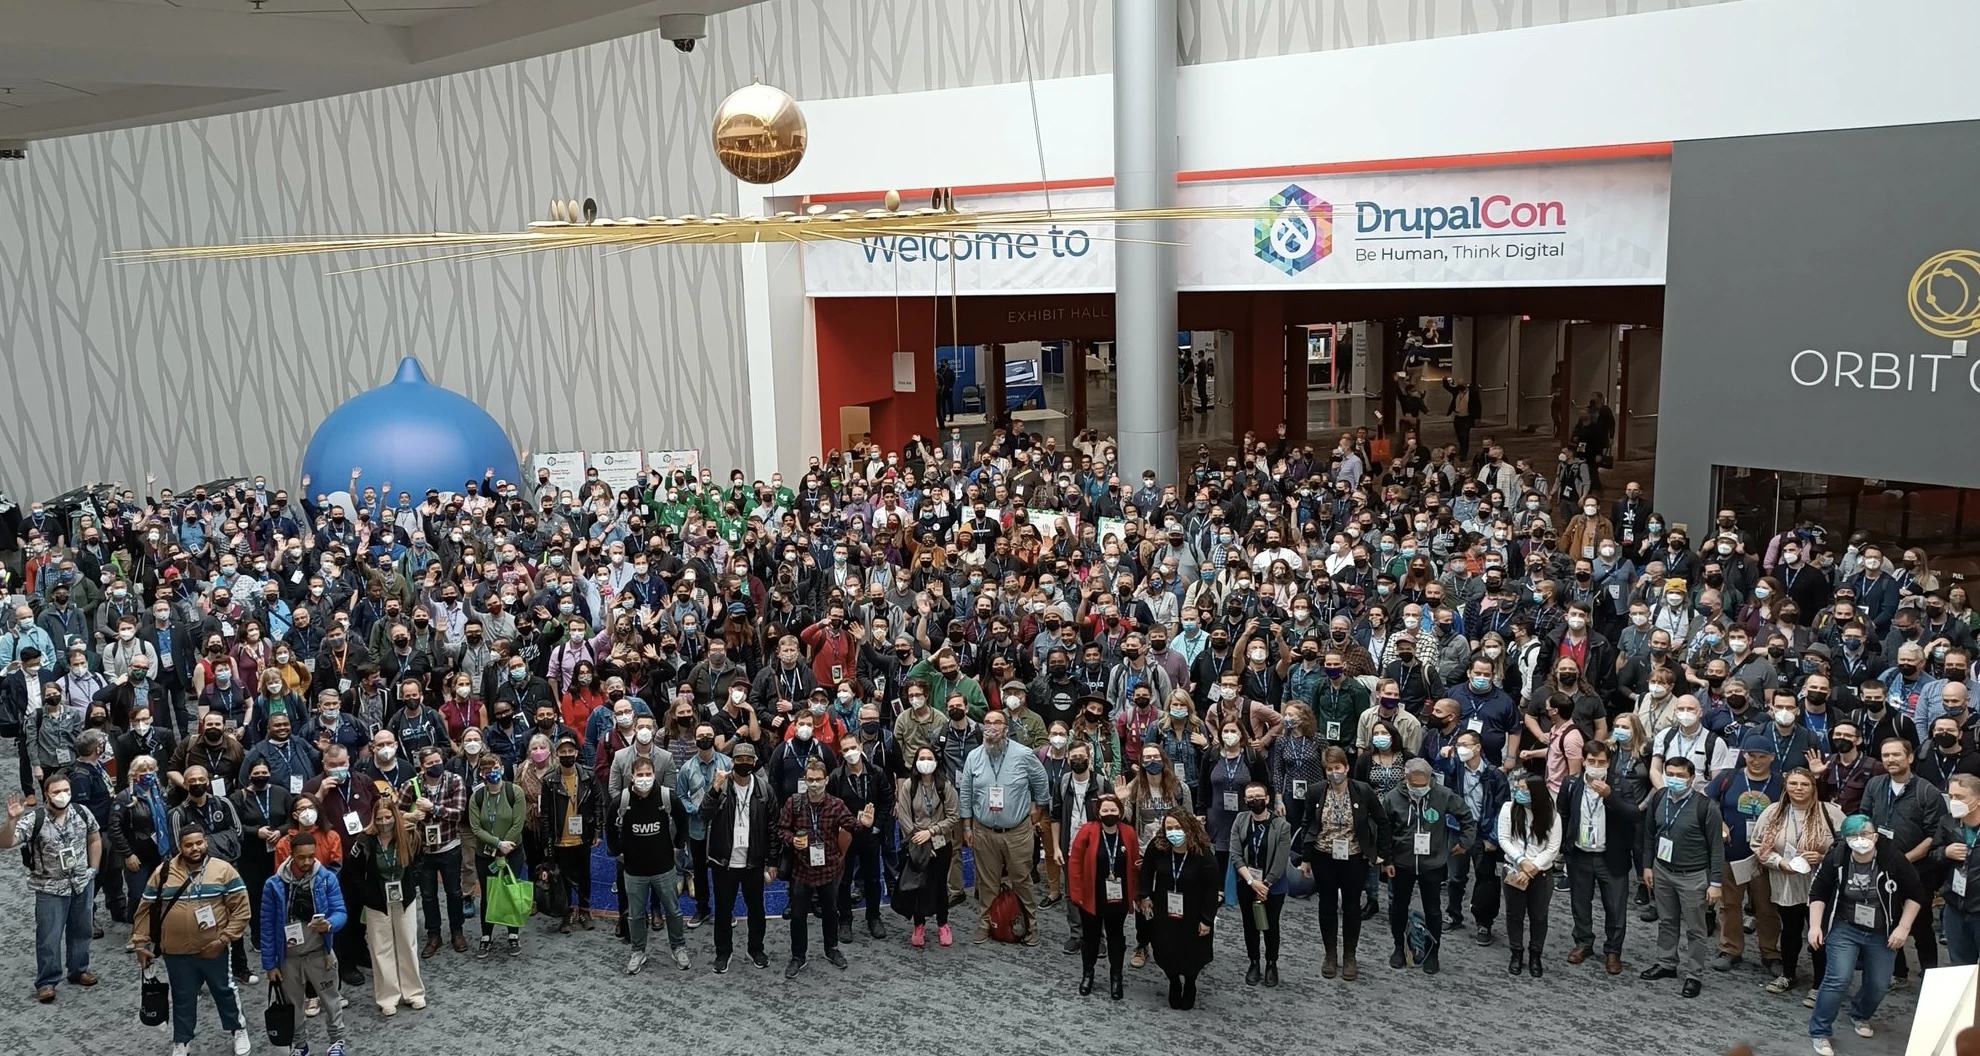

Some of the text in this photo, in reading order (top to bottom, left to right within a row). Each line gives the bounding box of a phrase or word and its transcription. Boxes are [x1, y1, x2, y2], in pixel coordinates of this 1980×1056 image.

[1355, 195, 1566, 239] DrupalCon
[861, 224, 1090, 263] Welcome to
[1355, 242, 1564, 262] Be Human, Think Digital
[1008, 306, 1109, 323] EXHIBIT HALL
[1790, 349, 1952, 392] ORBIT
[632, 821, 661, 834] SWIS
